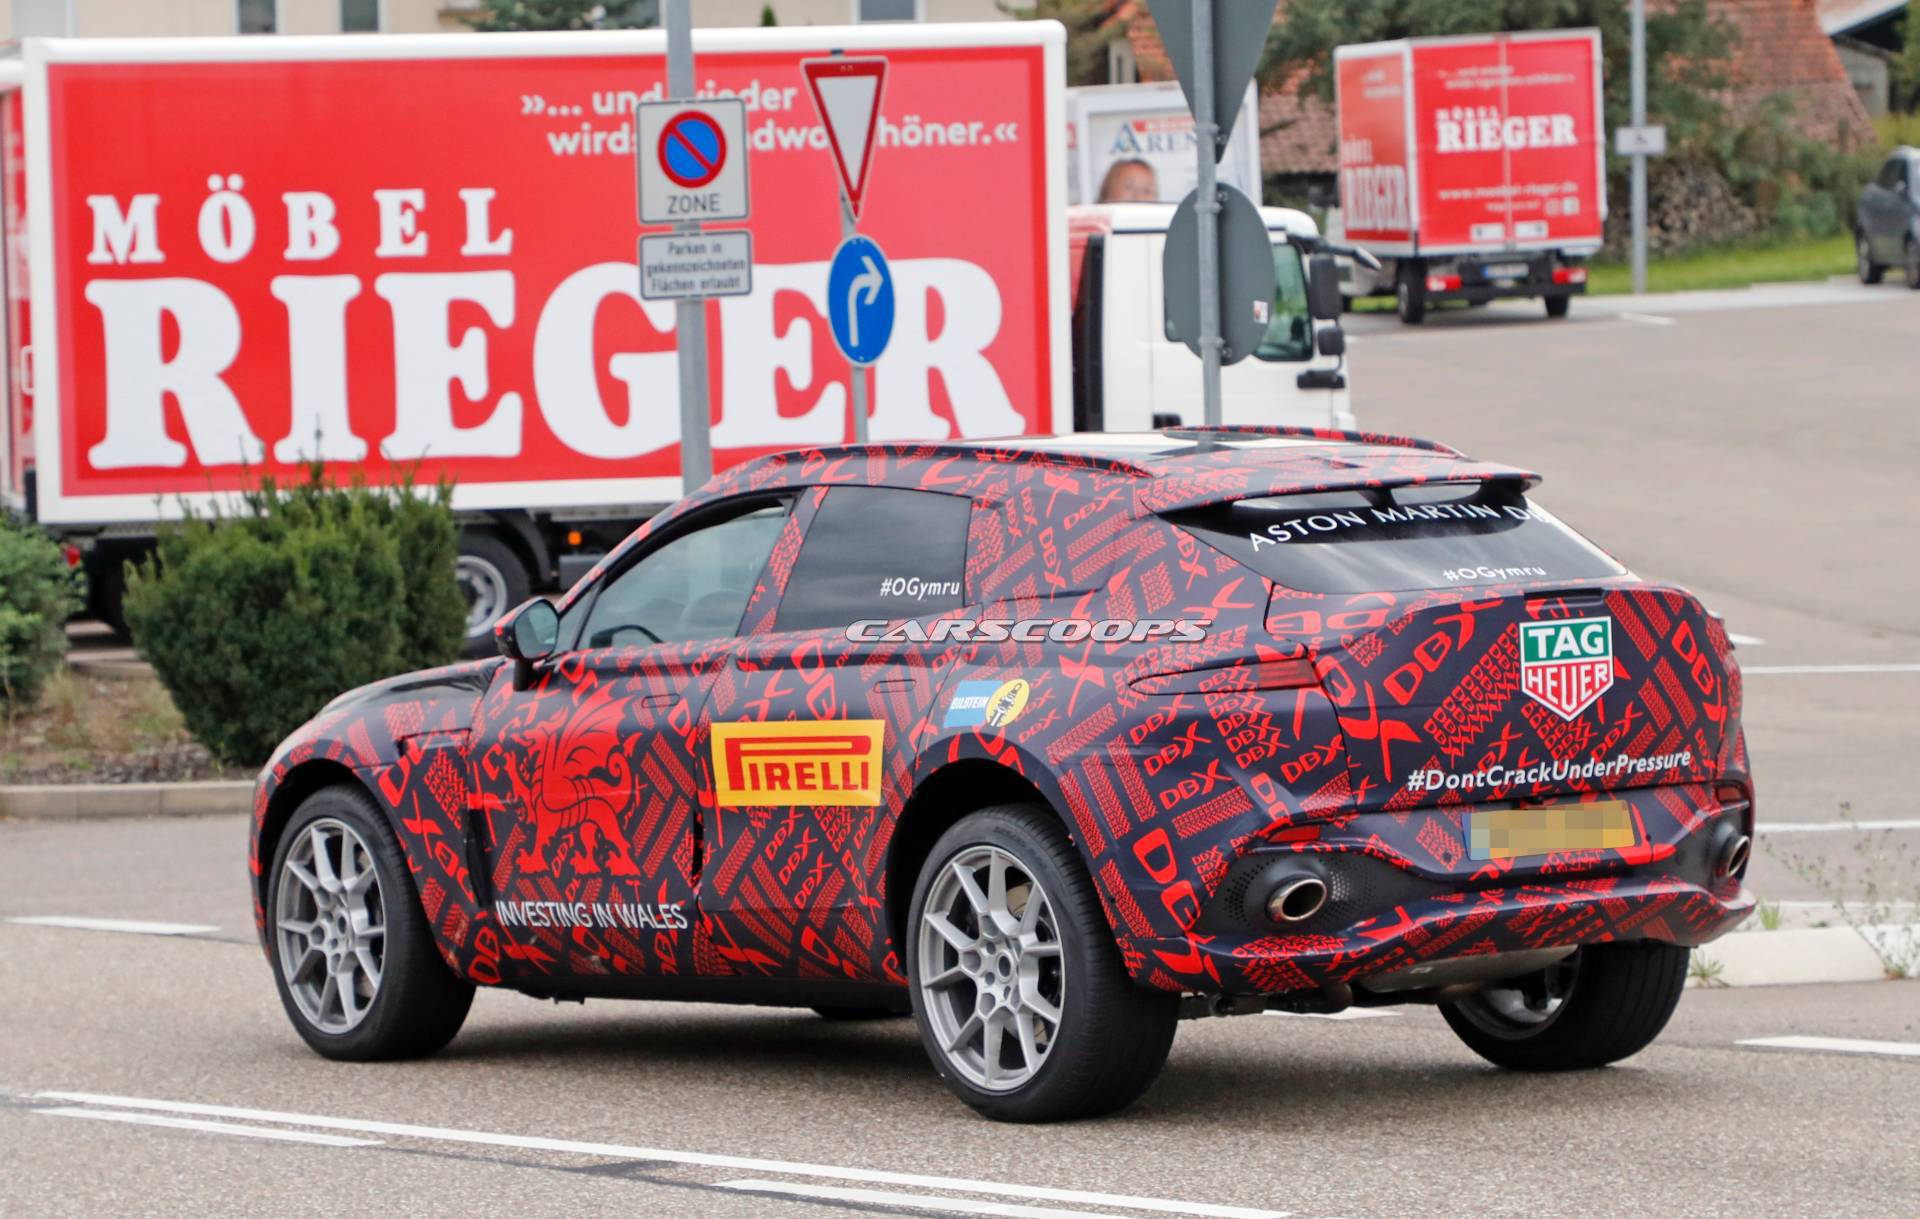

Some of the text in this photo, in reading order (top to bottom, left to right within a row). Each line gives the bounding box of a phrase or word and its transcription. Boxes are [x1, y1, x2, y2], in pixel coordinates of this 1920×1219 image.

[547, 122, 638, 155] wird
[1436, 113, 1578, 154] RIEGER
[86, 174, 514, 264] MÖBEL
[667, 193, 721, 214] ZONE
[668, 241, 723, 256] Parken in
[652, 275, 741, 292] Flächen erlaubt
[85, 257, 1026, 470] RIEGER
[1249, 510, 1367, 552] ASTON
[1371, 503, 1502, 524] MARTIN
[880, 578, 960, 601] #OGymru
[1443, 566, 1547, 580] #OGymru
[1528, 624, 1604, 659] TAG
[950, 695, 990, 710] BILSTEIN
[1527, 663, 1608, 713] HEUER
[1129, 692, 1195, 745] DBX
[725, 736, 871, 791] PIRELLI
[1143, 721, 1212, 777] DBX
[1280, 733, 1347, 784] DBX
[1408, 748, 1692, 793] #DontCrackUnderPressure
[1159, 759, 1232, 810] DBX
[794, 851, 833, 909] DBX
[496, 900, 689, 930] INVESTING IN WALES
